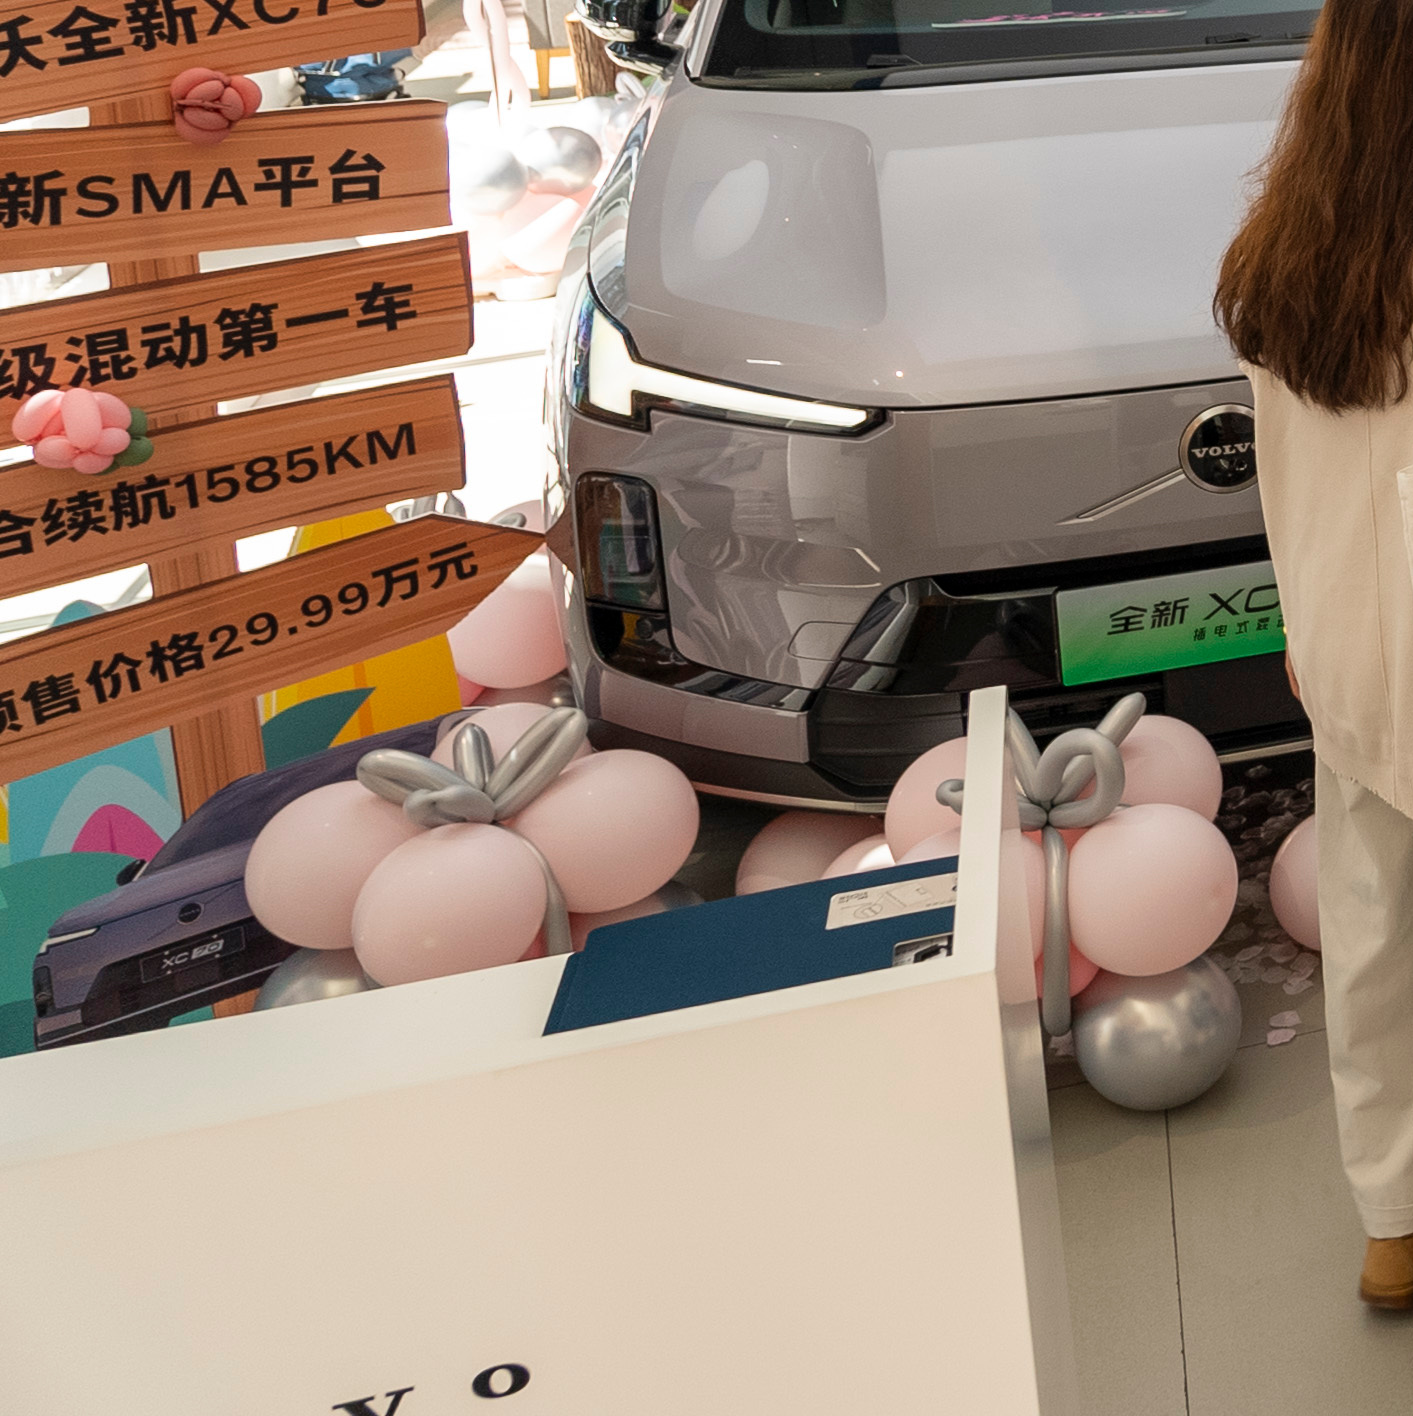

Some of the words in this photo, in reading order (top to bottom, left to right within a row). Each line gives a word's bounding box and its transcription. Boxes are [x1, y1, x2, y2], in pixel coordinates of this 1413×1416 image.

[1191, 442, 1256, 459] VOLV
[1107, 597, 1190, 636] 全新
[1203, 583, 1281, 621] XC
